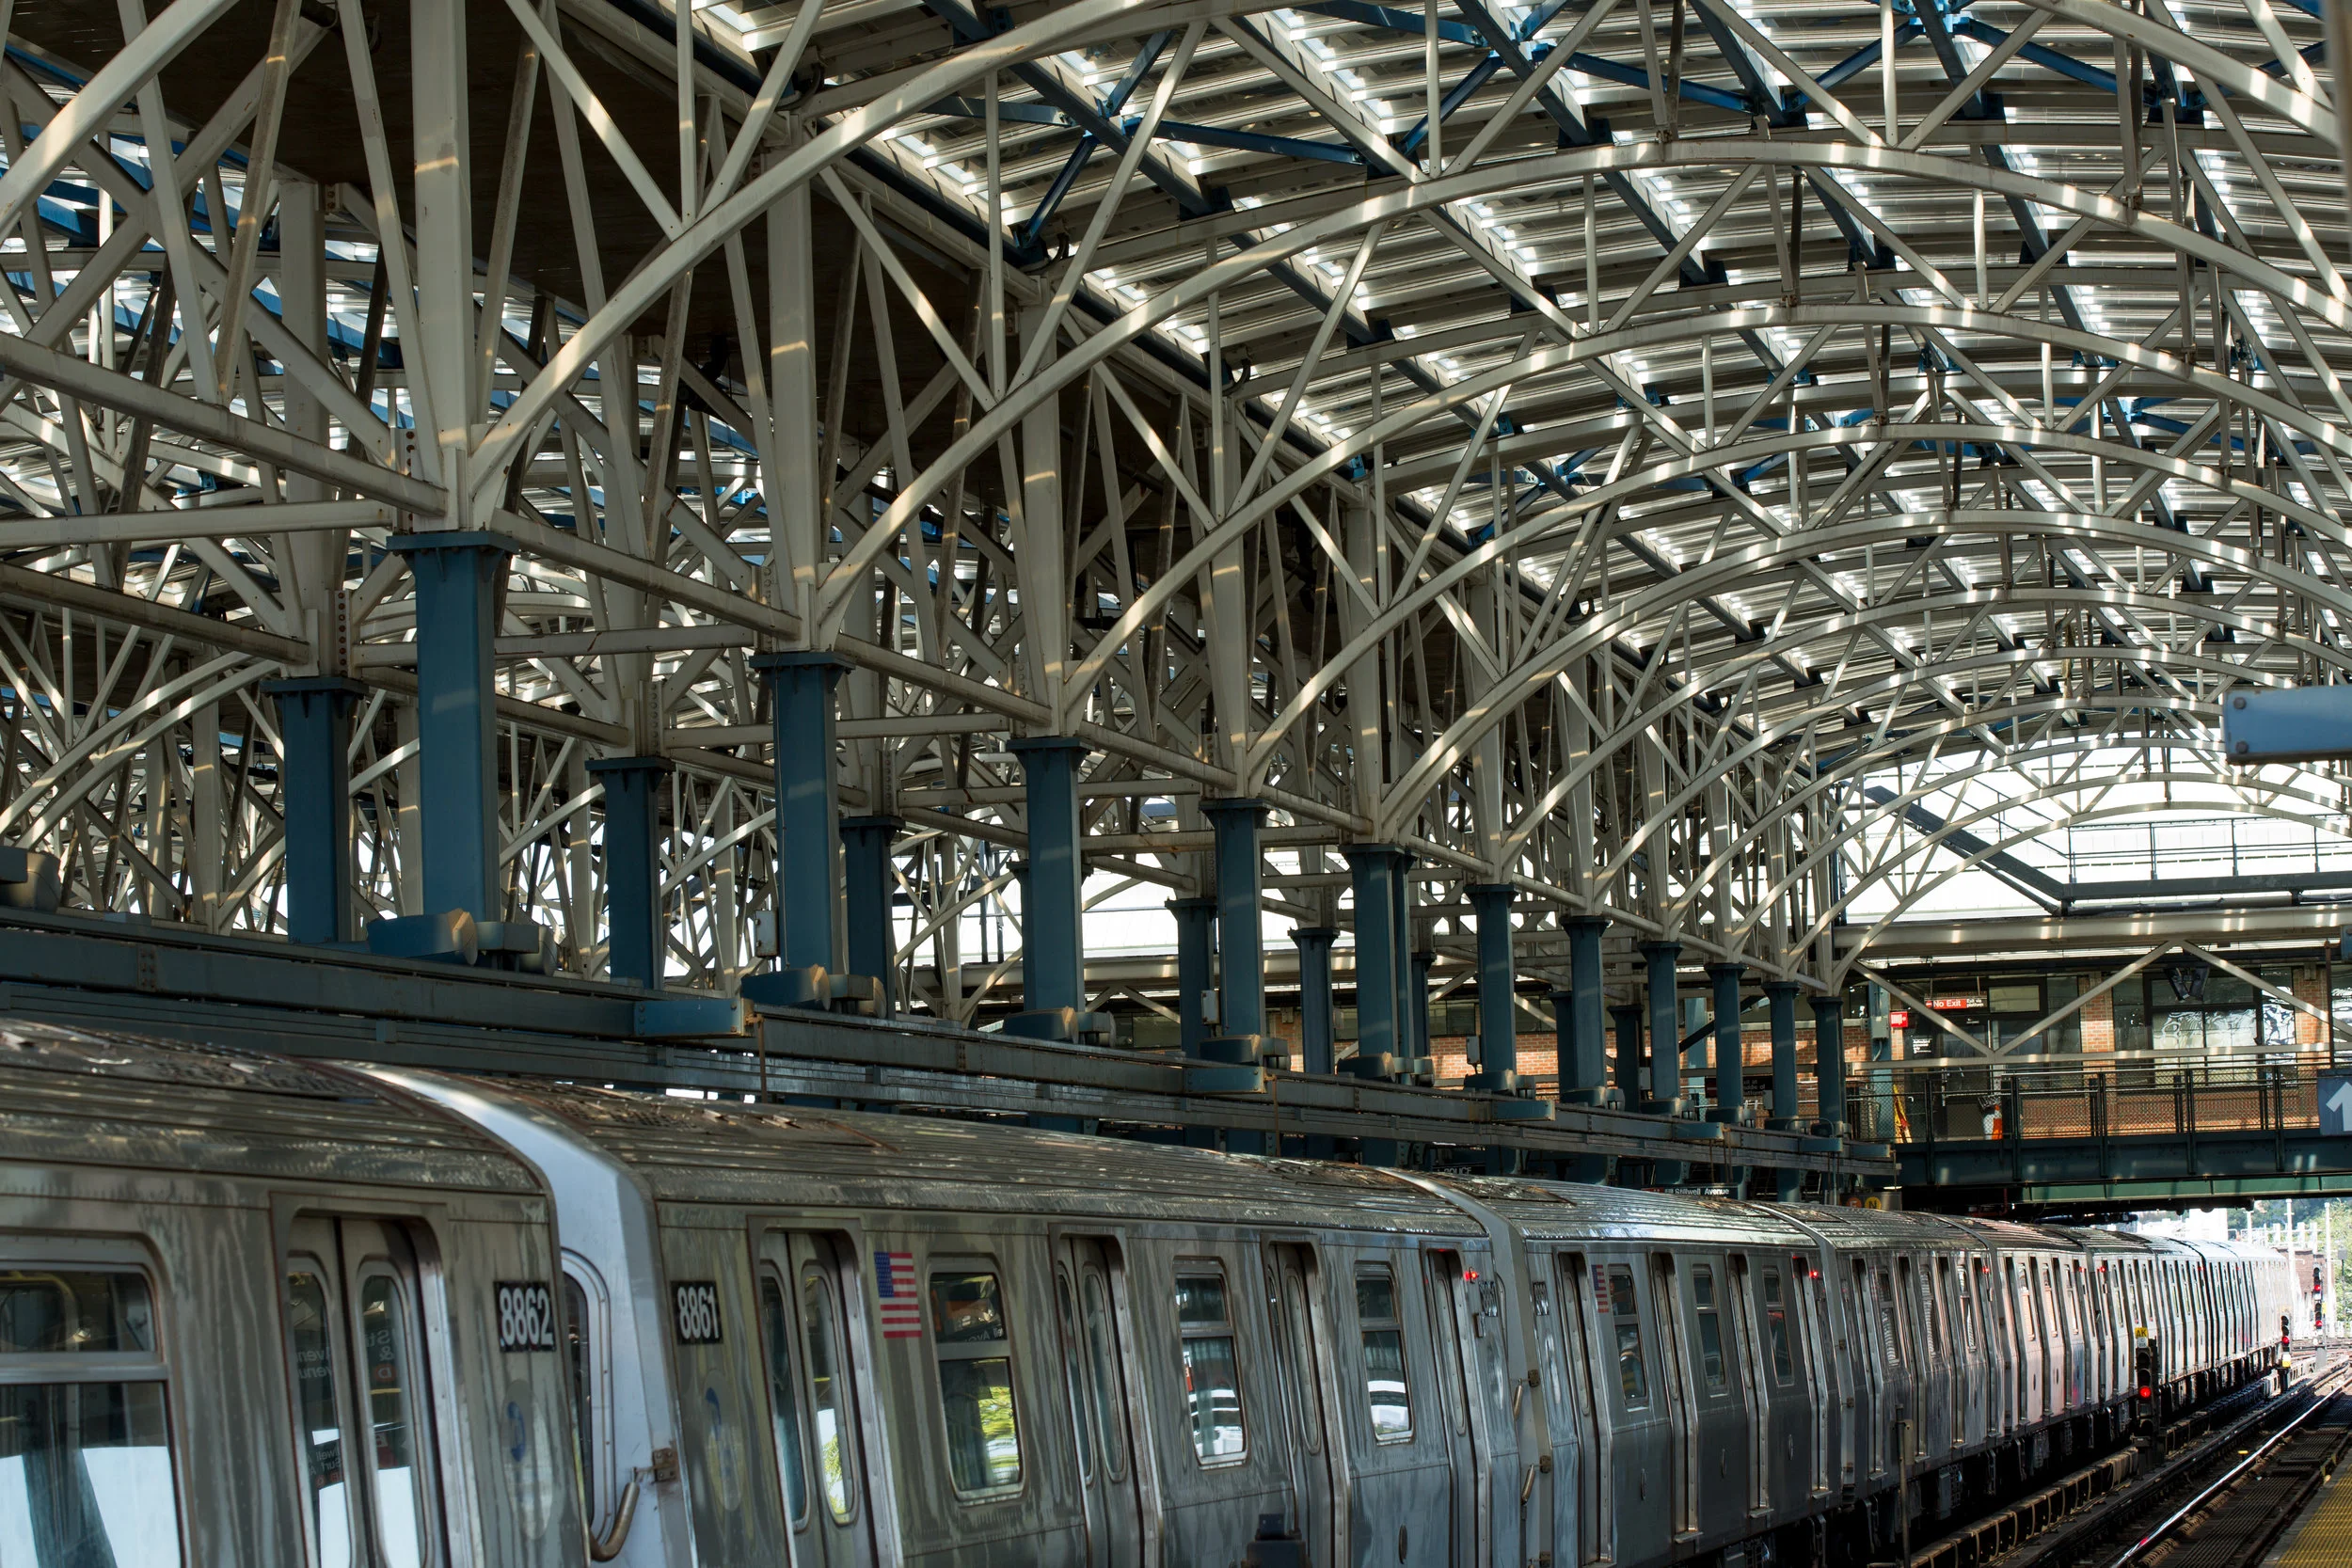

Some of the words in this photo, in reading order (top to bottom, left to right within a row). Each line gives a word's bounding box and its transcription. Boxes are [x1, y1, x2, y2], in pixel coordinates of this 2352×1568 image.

[1932, 999, 1945, 1008] No
[1946, 998, 1962, 1007] Exit
[1675, 1187, 1702, 1196] Stillwell
[1704, 1187, 1730, 1196] Avenue
[1868, 1200, 1878, 1209] N
[499, 1287, 554, 1346] 8862
[676, 1286, 720, 1339] 8861
